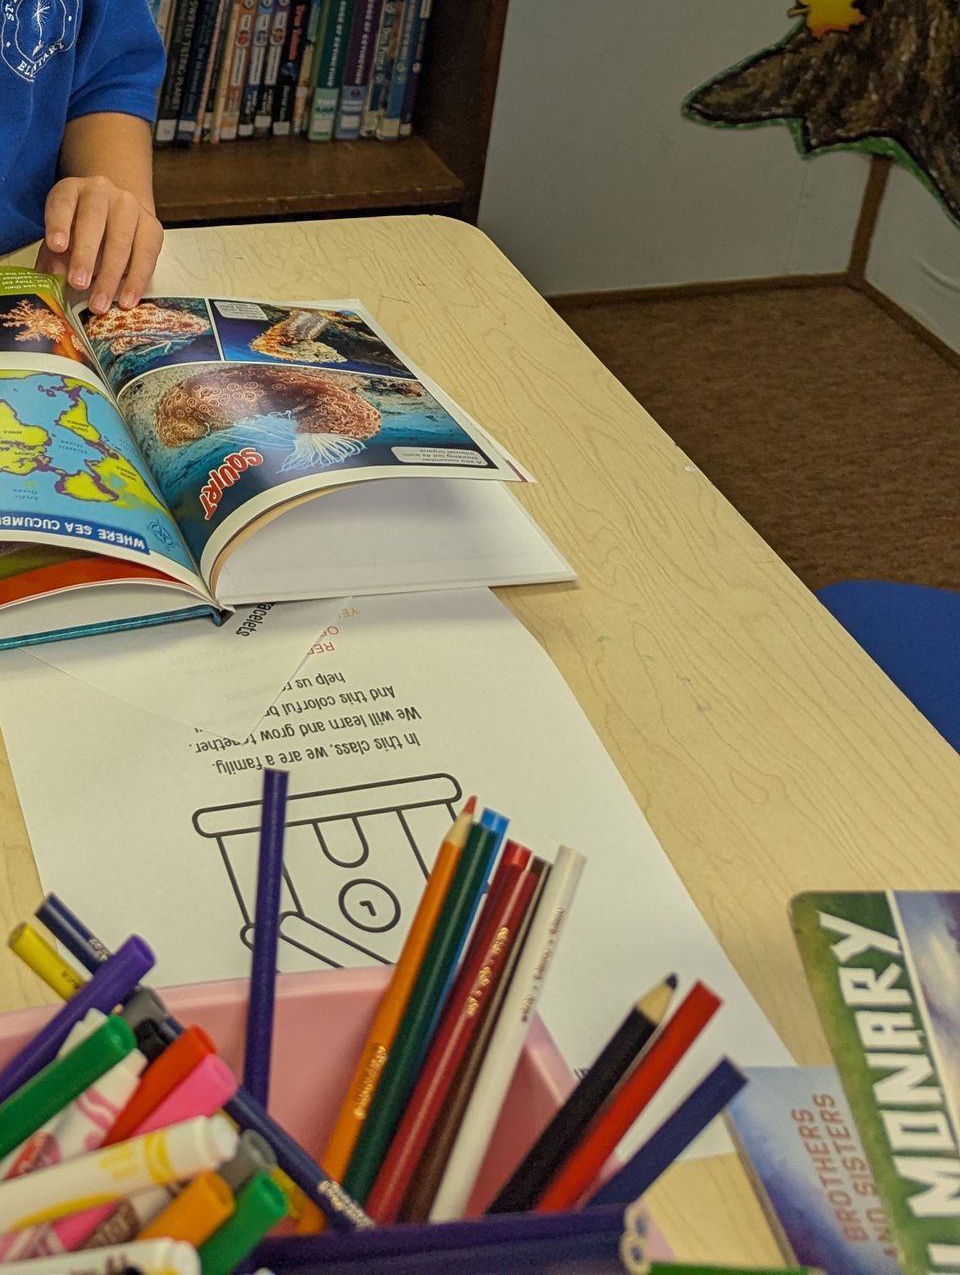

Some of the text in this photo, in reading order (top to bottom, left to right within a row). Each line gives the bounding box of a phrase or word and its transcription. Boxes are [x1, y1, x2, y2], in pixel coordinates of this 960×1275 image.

[198, 447, 264, 521] SQUIRT
[64, 522, 92, 535] SEA
[96, 528, 145, 550] WHERE
[295, 672, 345, 689] help us
[281, 685, 396, 715] And this colorful
[368, 710, 393, 728] will
[396, 706, 422, 721] We
[299, 721, 325, 738] and
[328, 714, 365, 733] learn
[260, 723, 294, 742] grow
[404, 732, 420, 747] In
[373, 736, 403, 752] this
[265, 754, 276, 766] a
[278, 750, 302, 765] are
[305, 747, 328, 759] we
[212, 756, 262, 776] family.
[812, 1093, 875, 1196] SISTERS
[790, 1109, 867, 1243] BROTHERS
